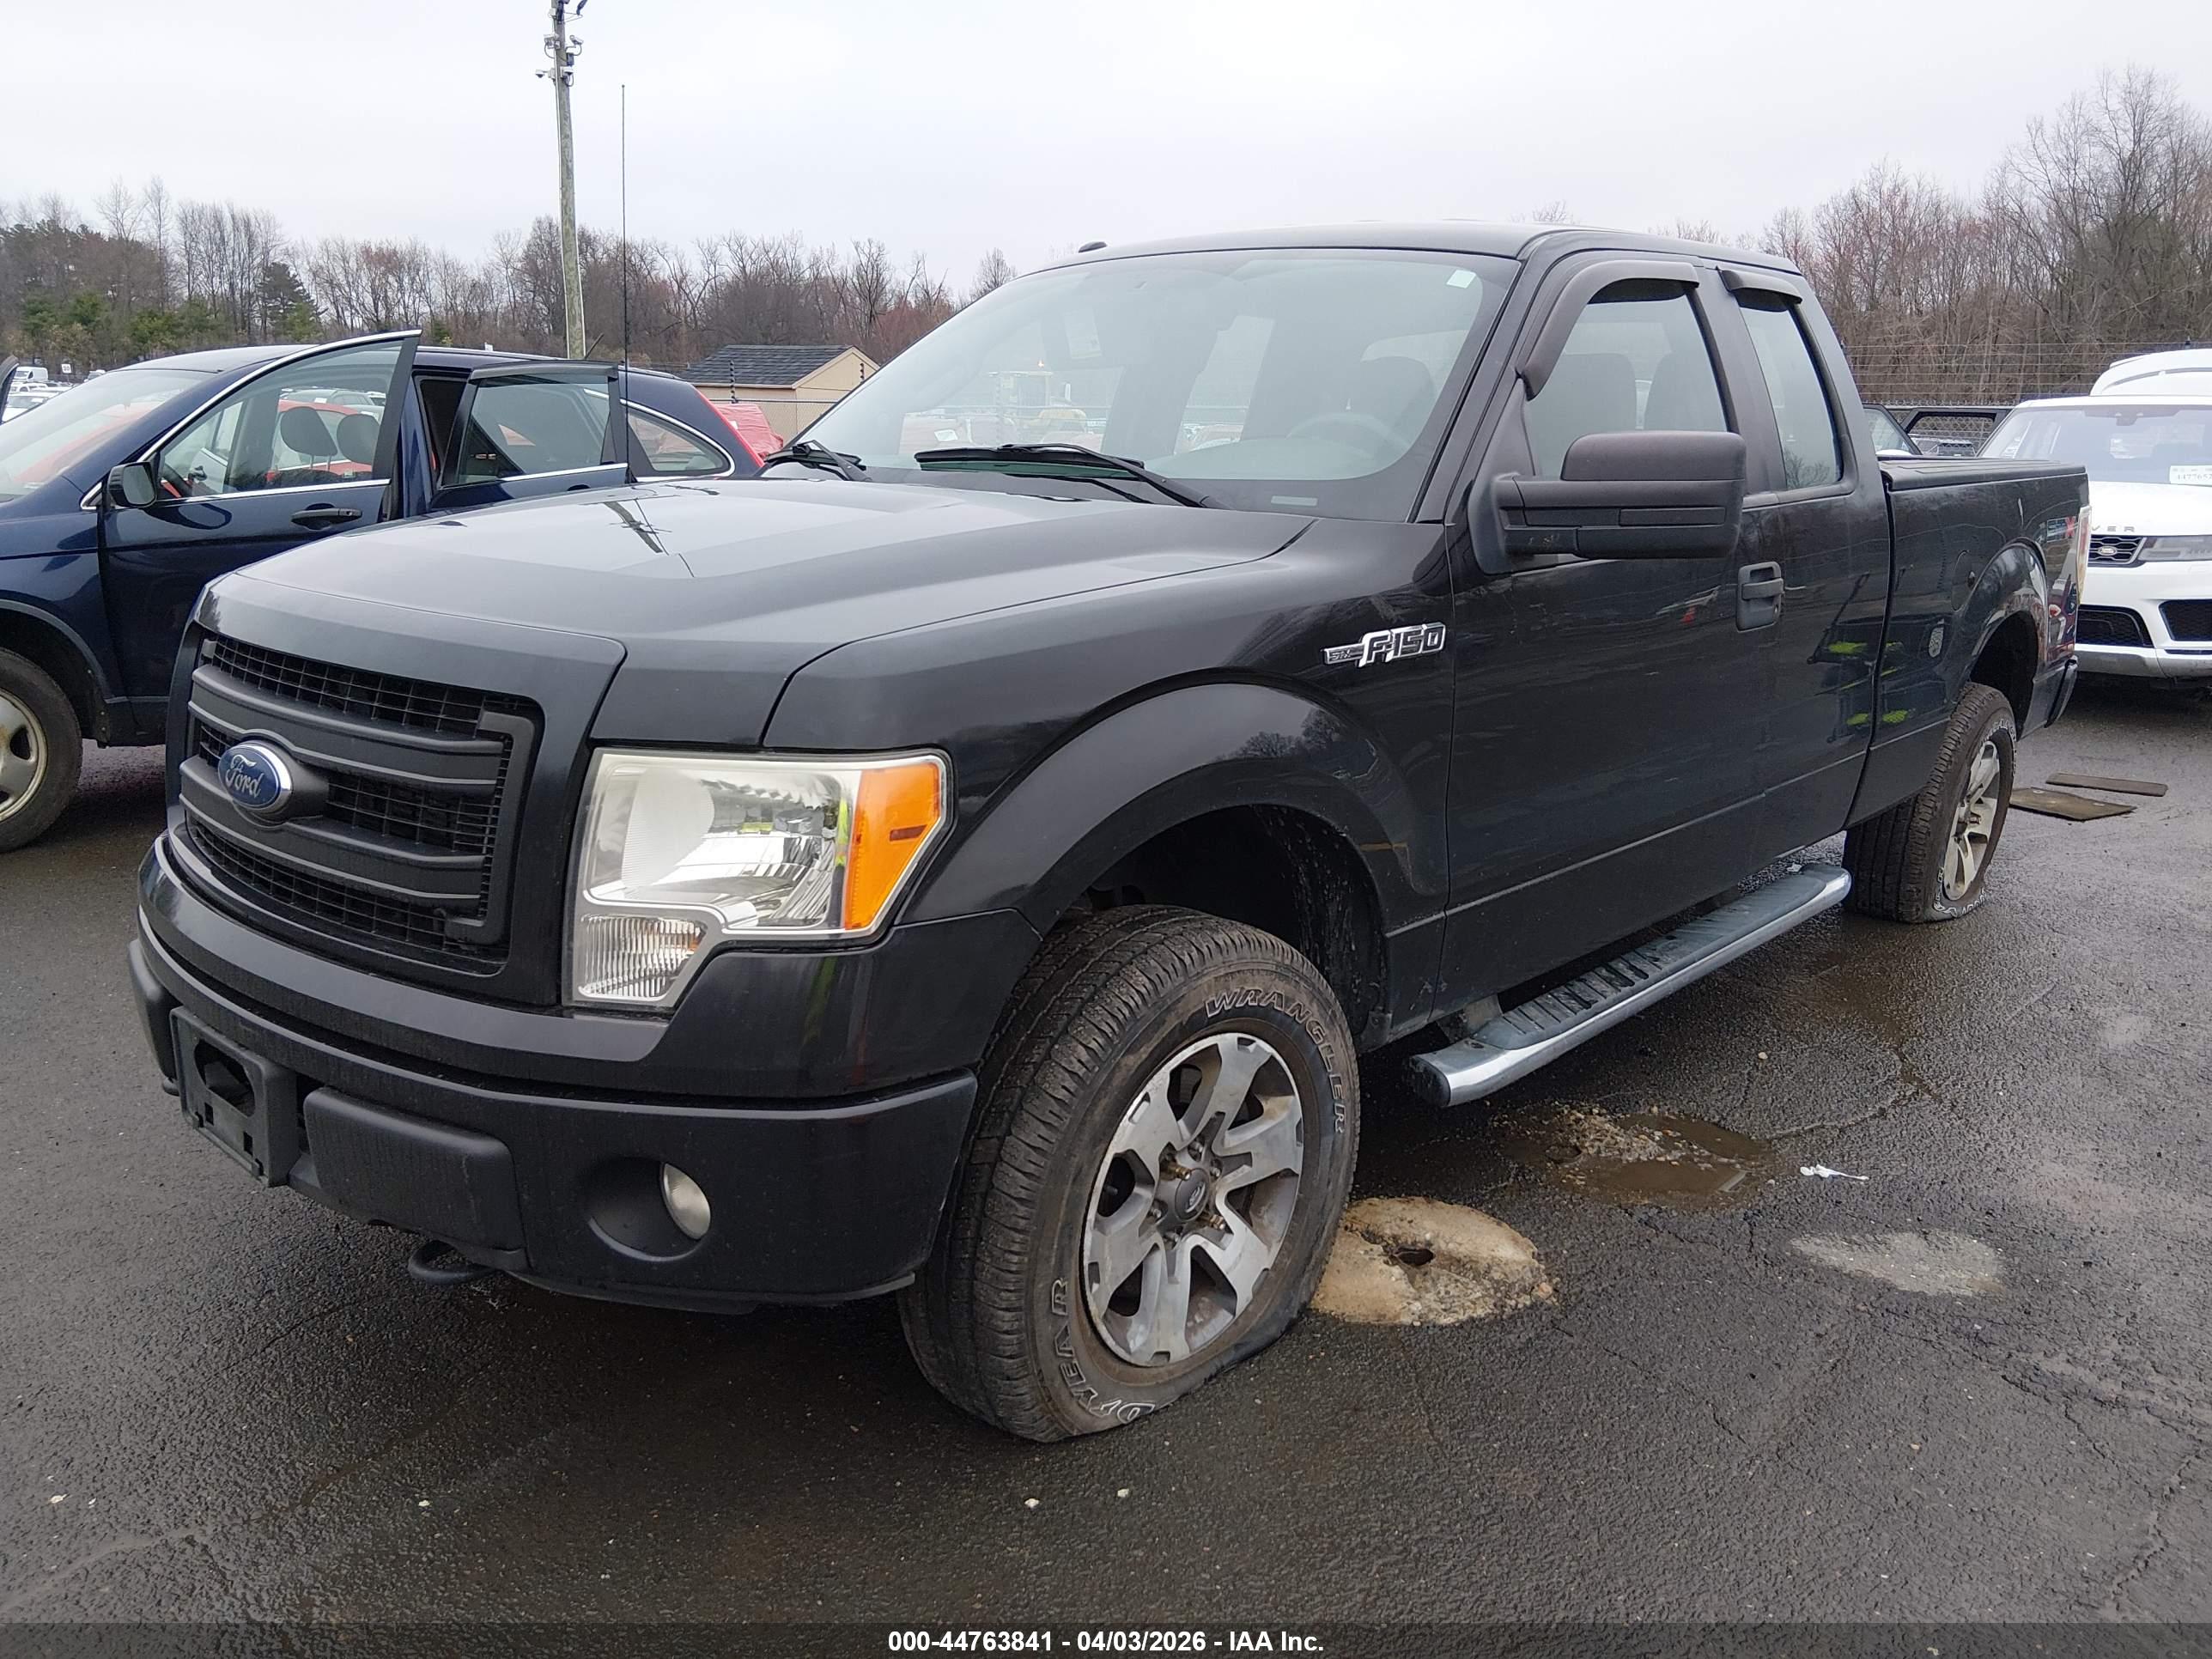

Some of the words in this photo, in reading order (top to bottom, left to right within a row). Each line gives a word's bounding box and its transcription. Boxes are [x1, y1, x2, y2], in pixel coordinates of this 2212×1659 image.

[225, 754, 265, 799] Ford
[1205, 988, 1346, 1133] WRANGLER
[1050, 1277, 1156, 1425] DYEAR
